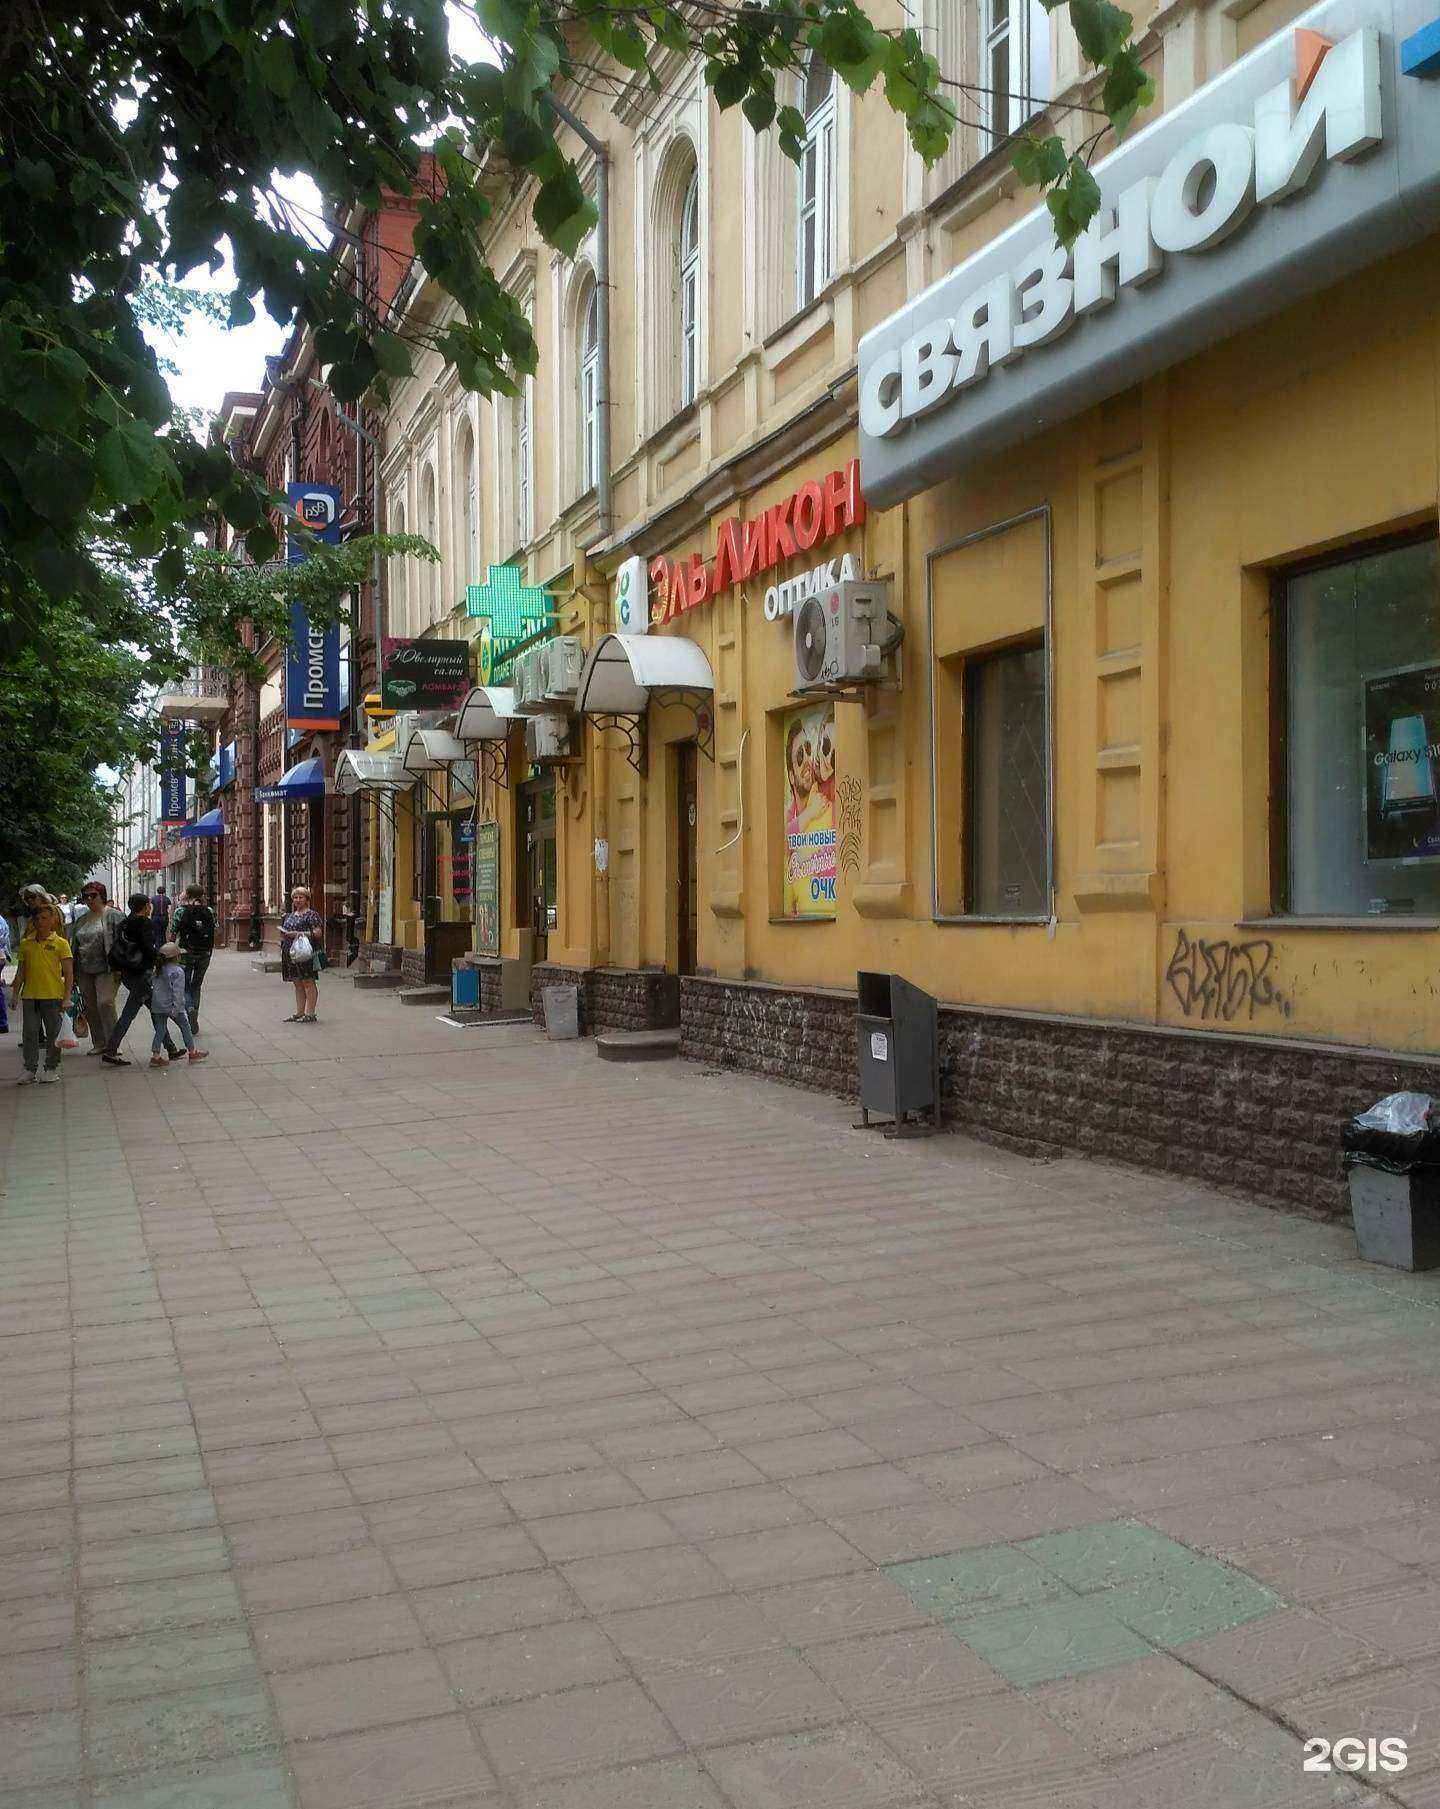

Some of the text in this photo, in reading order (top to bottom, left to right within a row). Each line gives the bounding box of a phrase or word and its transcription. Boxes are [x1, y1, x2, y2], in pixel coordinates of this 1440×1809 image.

[859, 28, 1382, 437] СВЯЗНОЙ
[764, 553, 855, 621] ОПТИКА
[1374, 748, 1420, 766] Galaxy
[811, 877, 837, 900] ОЧК
